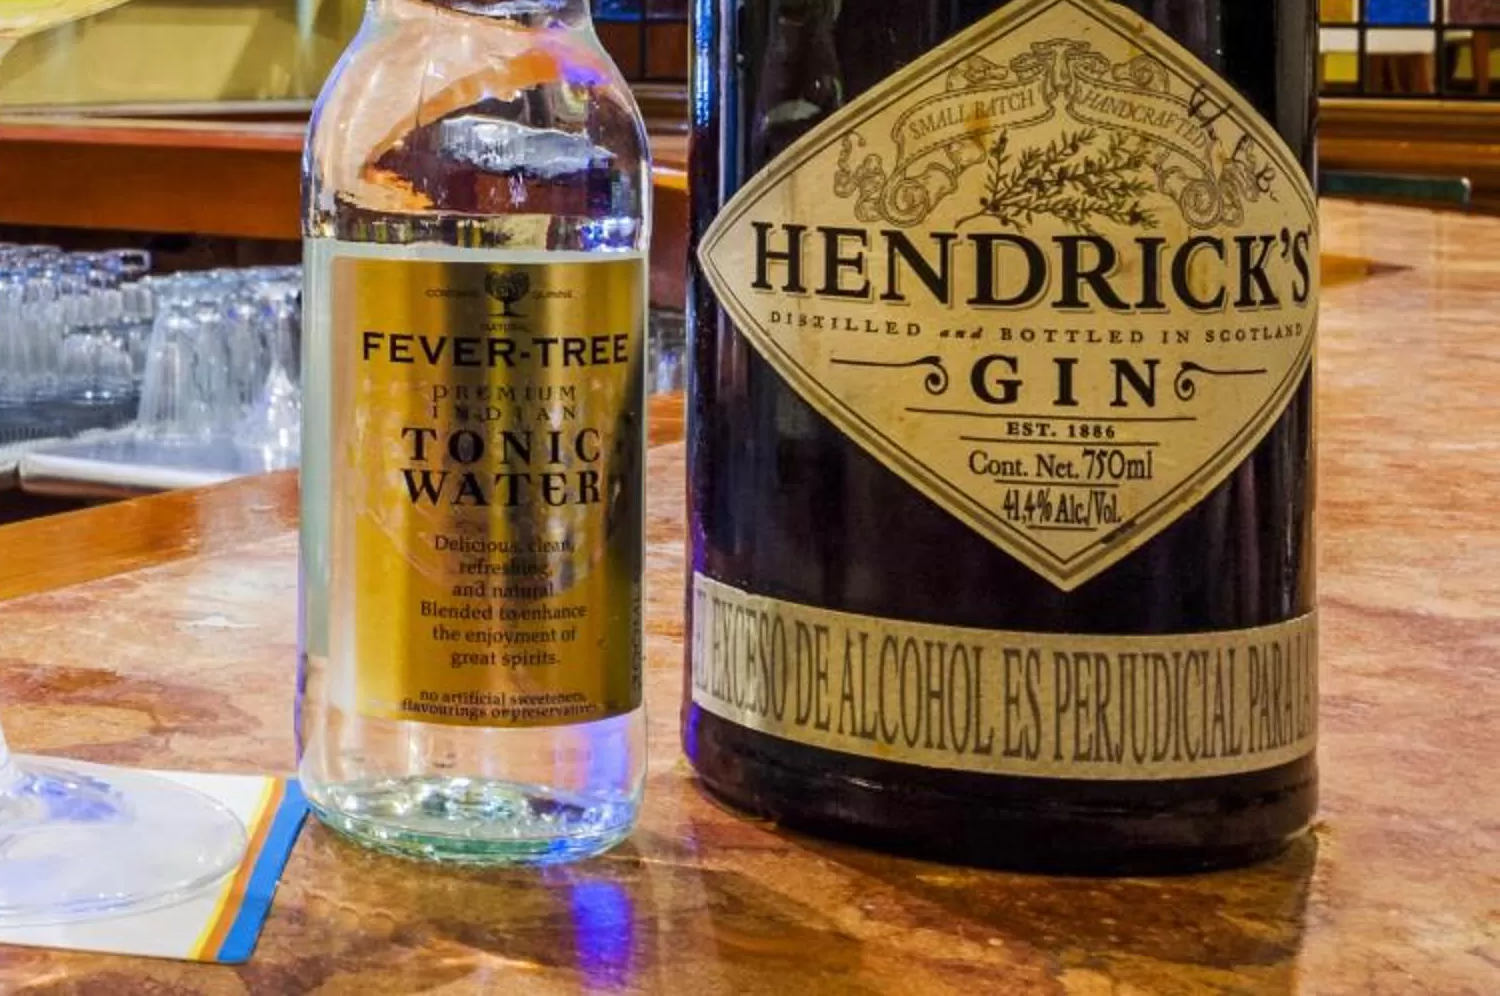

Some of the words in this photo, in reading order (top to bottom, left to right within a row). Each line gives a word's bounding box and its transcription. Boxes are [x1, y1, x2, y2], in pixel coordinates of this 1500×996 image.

[975, 88, 1035, 121] BATCH
[909, 103, 965, 141] SMALL
[751, 221, 1311, 309] HENDRICK'S
[770, 310, 921, 337] DISTILLED
[939, 326, 984, 340] and
[1000, 327, 1144, 344] BOTTLED
[1161, 329, 1191, 344] IN
[1205, 322, 1302, 343] SCOTLAND
[362, 331, 629, 368] FEVER-TREE
[432, 384, 576, 402] PREMIUM
[969, 354, 1161, 408] GIN
[431, 405, 576, 422] INDIAN
[1006, 421, 1057, 437] EST.
[1068, 423, 1116, 439] 1886
[401, 427, 601, 464] TONIC
[968, 449, 1029, 477] Cont.
[1034, 453, 1080, 479] Net.
[1081, 447, 1154, 481] 750ml
[400, 468, 602, 507] WATER
[452, 580, 485, 597] and
[420, 600, 493, 621] Blended
[520, 602, 588, 621] enhance
[432, 624, 461, 641] the
[465, 626, 558, 648] enjoyment
[560, 626, 576, 641] of
[451, 652, 497, 669] great
[420, 690, 438, 701] no
[712, 597, 787, 722] EXCESO
[795, 619, 831, 732] DE
[837, 628, 994, 757] ALCOHOL
[1003, 648, 1043, 761] ES
[1052, 647, 1243, 764] PERJUDICIAL
[1248, 639, 1293, 753] PARA
